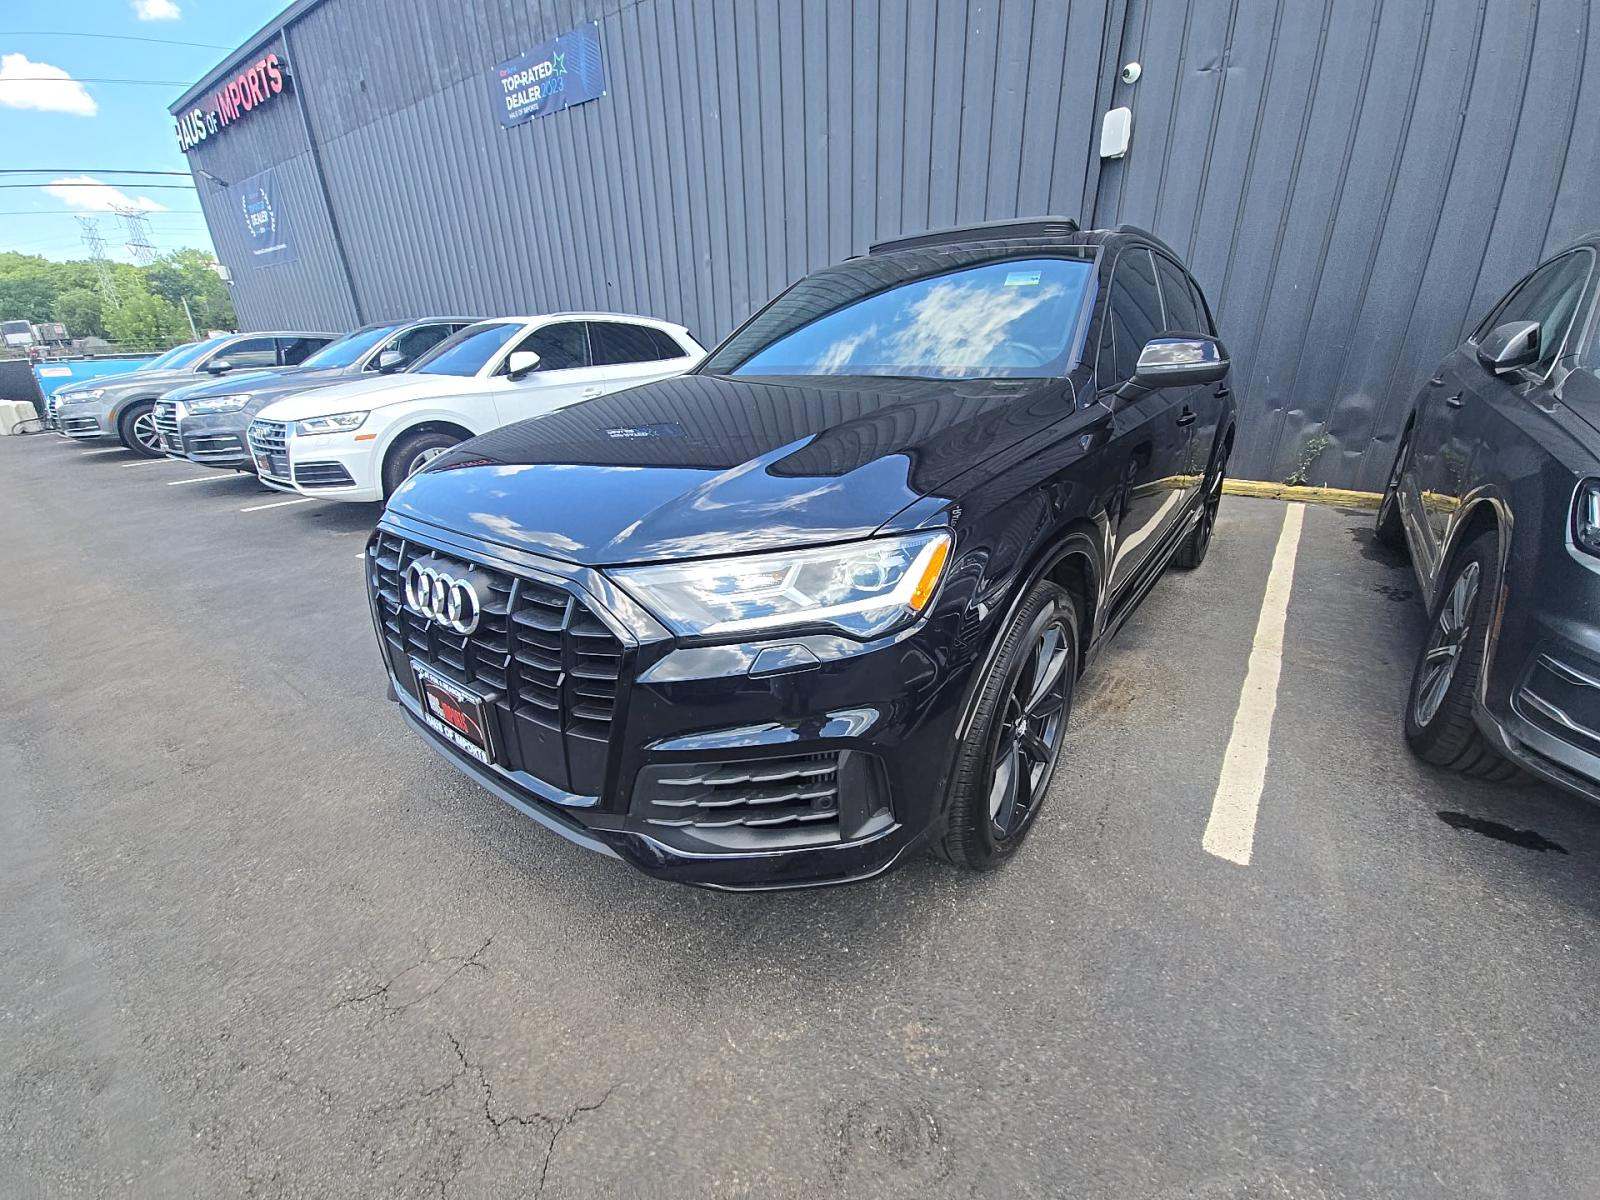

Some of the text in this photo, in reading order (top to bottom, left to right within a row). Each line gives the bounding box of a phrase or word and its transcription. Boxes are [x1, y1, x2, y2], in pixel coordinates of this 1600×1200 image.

[501, 61, 552, 92] TOP-RATED
[175, 53, 282, 151] HAUS OF IMPORTS
[505, 85, 541, 110] DEALER
